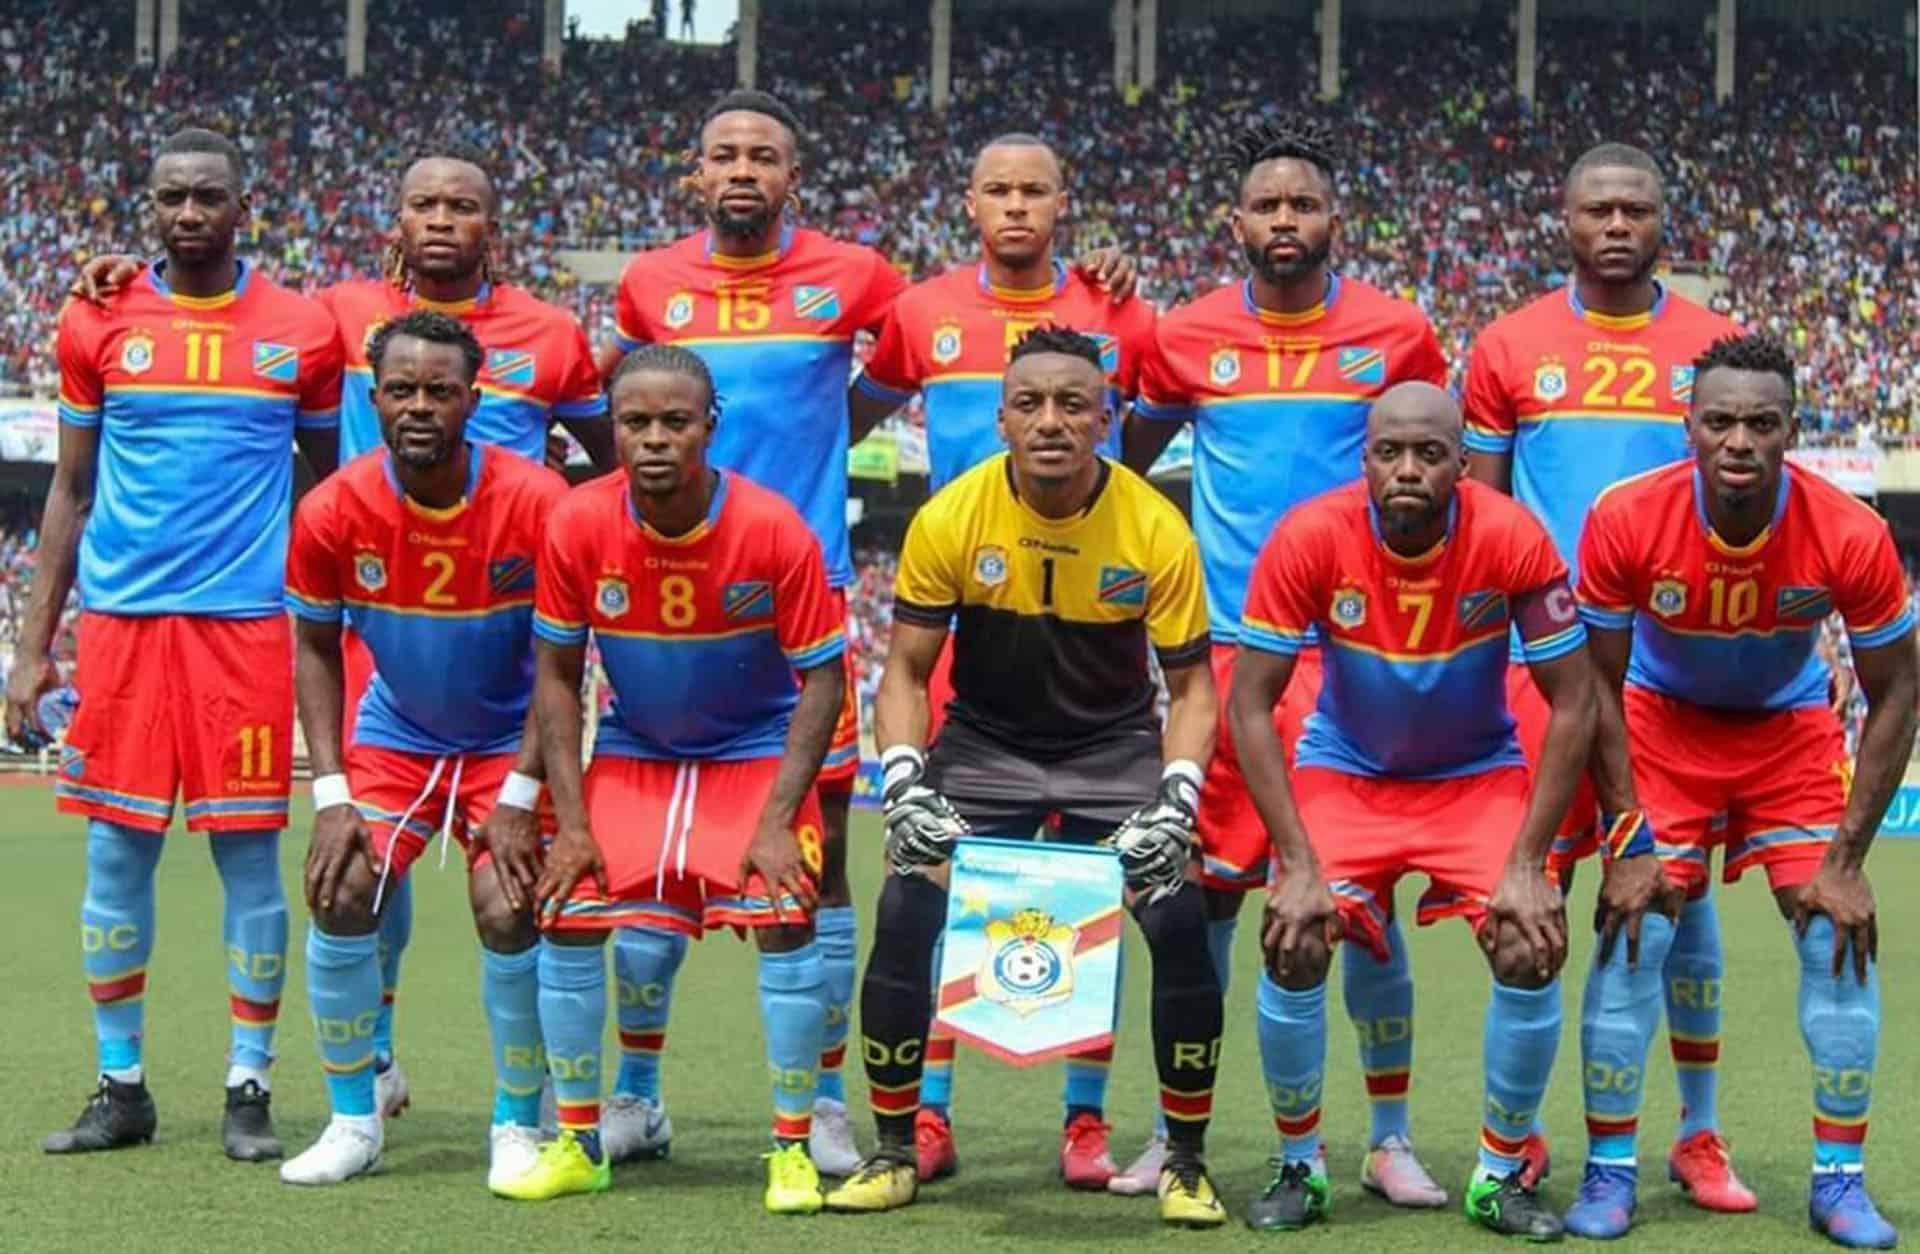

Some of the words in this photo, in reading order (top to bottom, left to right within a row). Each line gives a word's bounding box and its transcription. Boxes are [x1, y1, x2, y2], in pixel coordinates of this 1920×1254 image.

[717, 288, 771, 332] 15
[185, 332, 223, 381] 11
[1265, 344, 1321, 388] 17
[1582, 356, 1656, 408] 22
[422, 551, 456, 605] 2
[660, 576, 696, 628] 8
[1042, 557, 1055, 606] 1
[1709, 578, 1759, 626] 10
[1396, 594, 1434, 650] 7
[1544, 588, 1577, 623] C
[238, 725, 273, 777] 11
[798, 824, 824, 874] 8
[863, 1035, 921, 1067] DC
